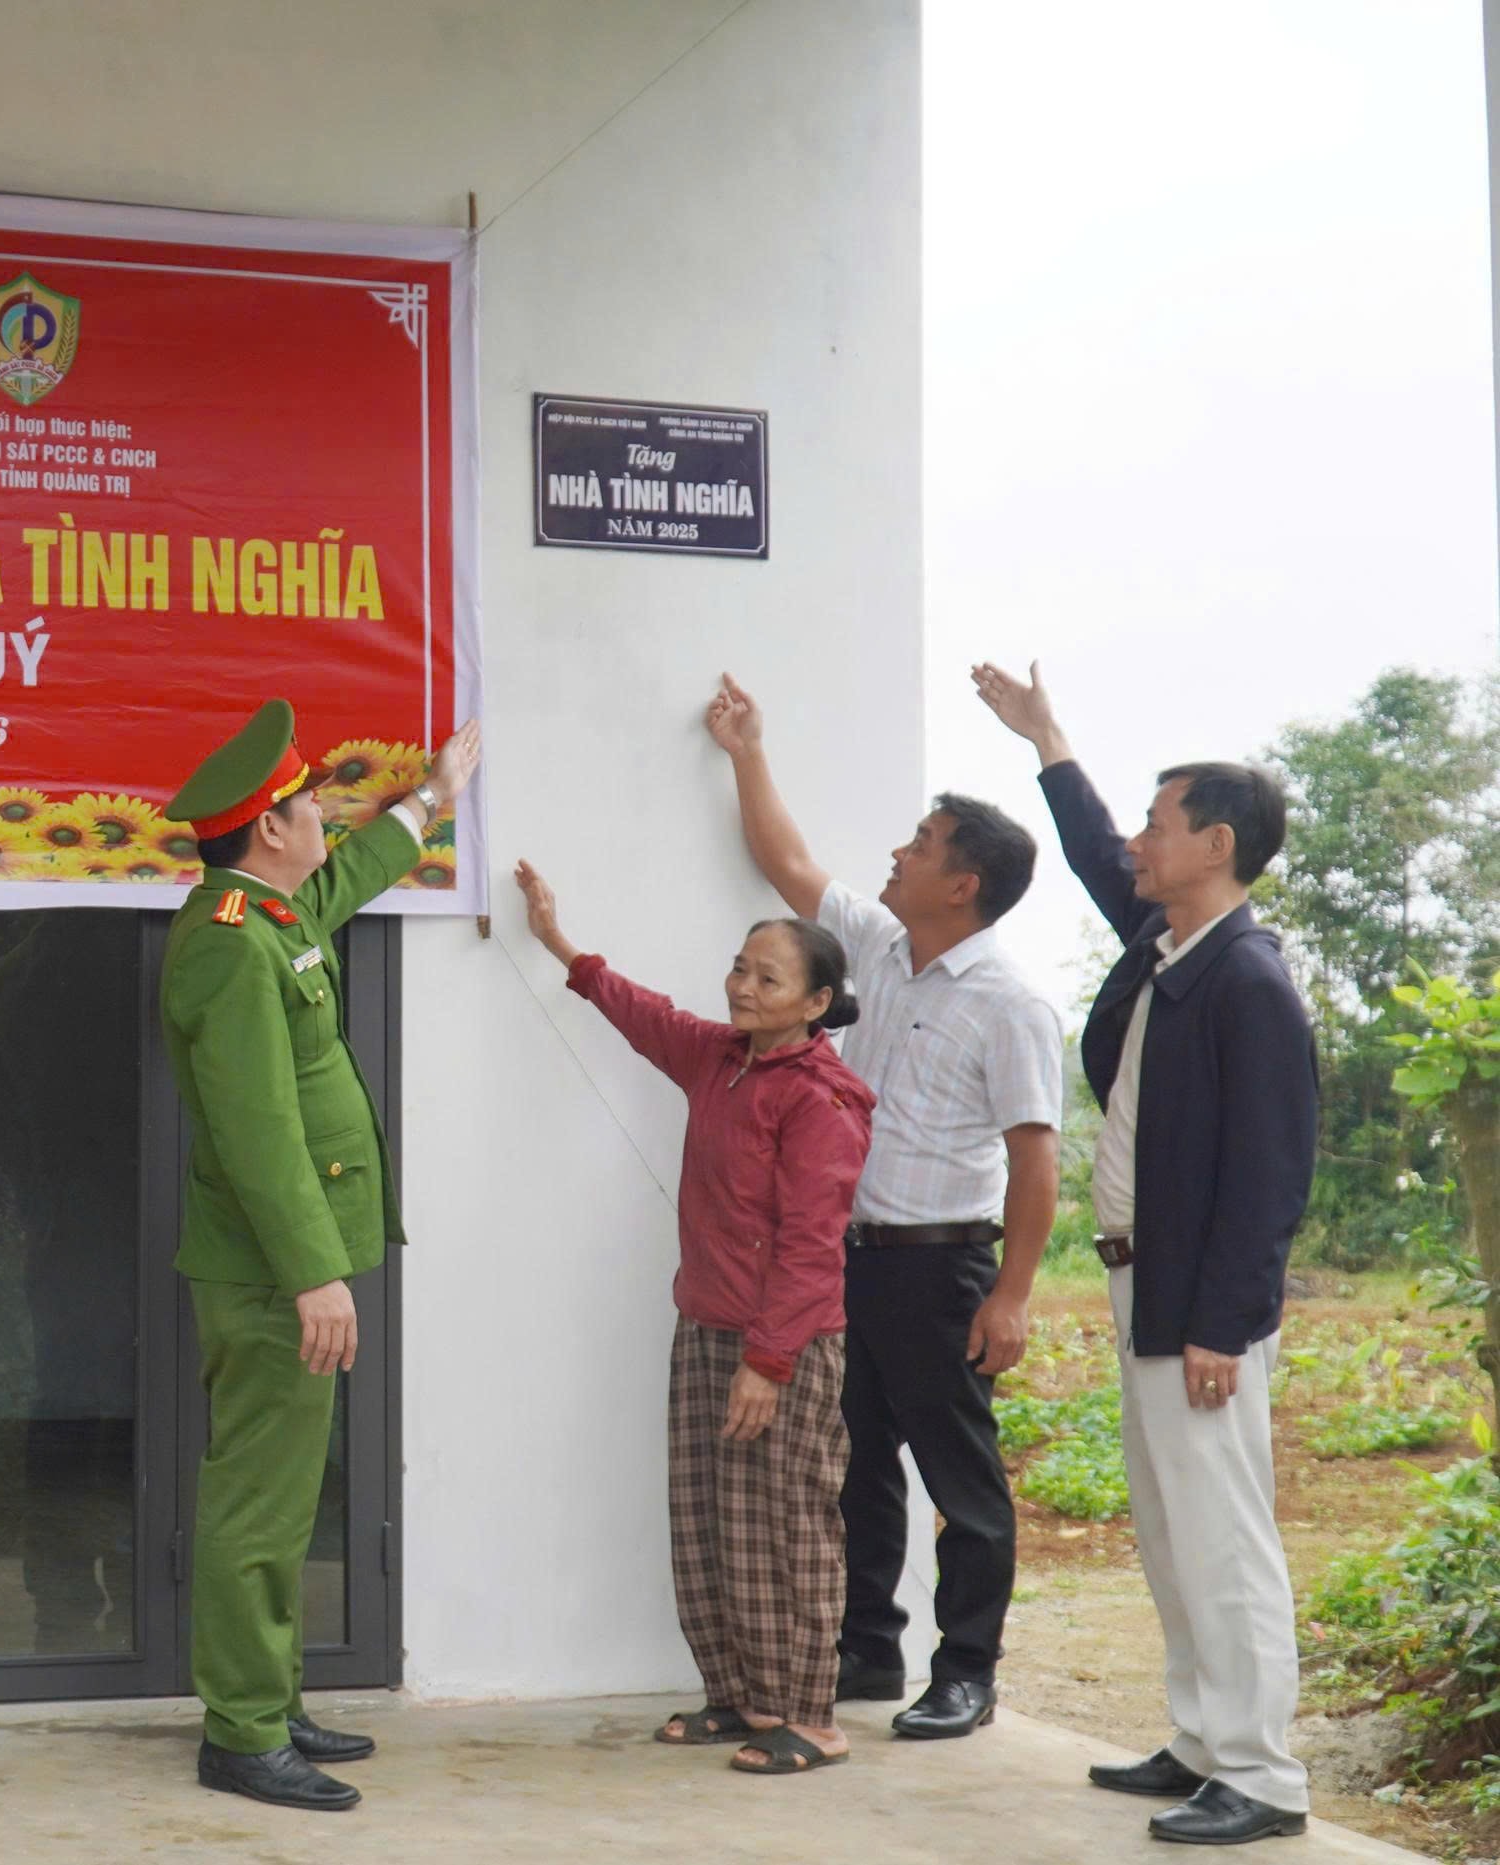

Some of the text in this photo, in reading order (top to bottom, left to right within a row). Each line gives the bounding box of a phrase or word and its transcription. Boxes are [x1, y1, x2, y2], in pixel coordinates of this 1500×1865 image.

[15, 415, 45, 436] hợp
[51, 417, 86, 441] thực
[92, 419, 132, 442] hiện:
[7, 440, 38, 461] SÁT
[44, 445, 87, 464] PCCC
[93, 448, 105, 465] &
[111, 448, 157, 468] CNCH
[627, 443, 676, 471] Tặng
[0, 463, 38, 489] TỈNH
[43, 467, 100, 492] QUẢNG
[104, 475, 131, 497] TRỊ
[549, 470, 755, 517] NHÀ TÌNH NGHĨA
[607, 515, 699, 540] NĂM 2025
[23, 512, 169, 611] TÌNH
[192, 528, 384, 620] NGHĨA
